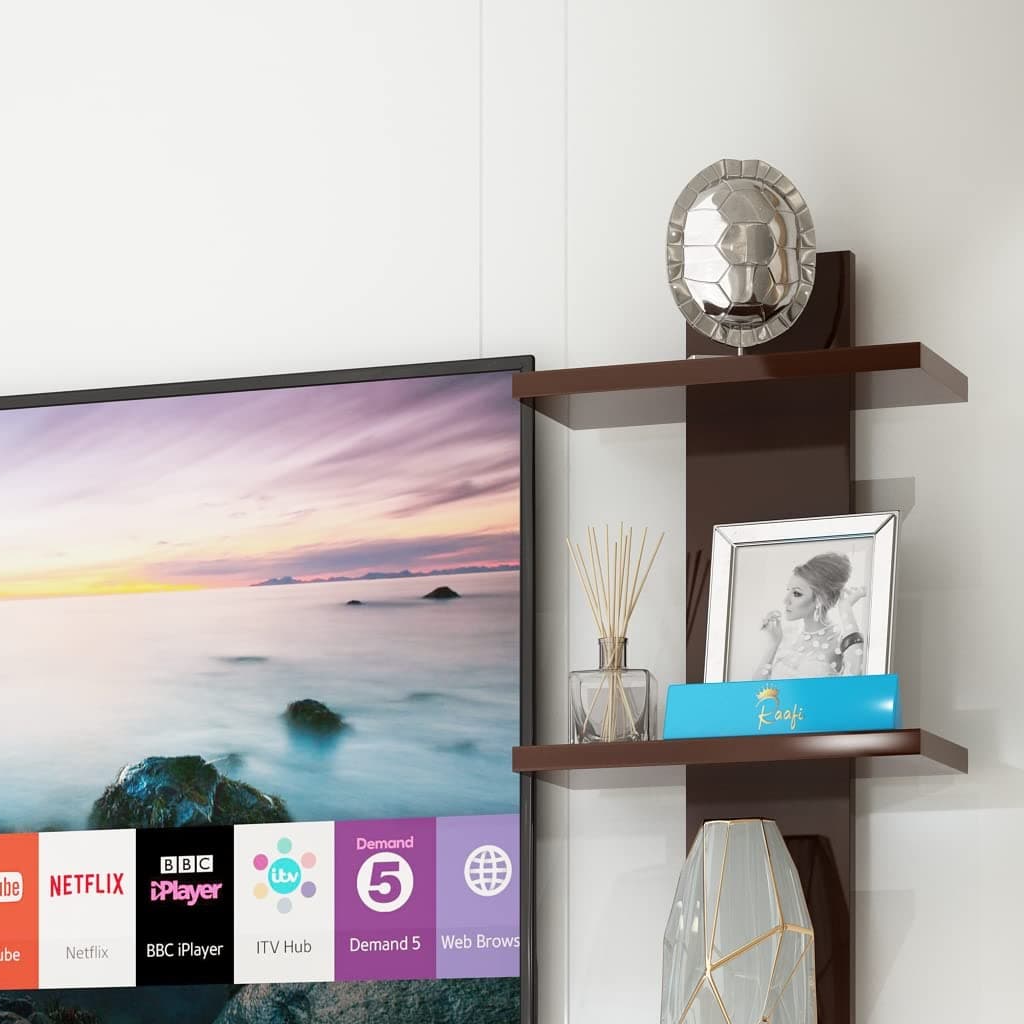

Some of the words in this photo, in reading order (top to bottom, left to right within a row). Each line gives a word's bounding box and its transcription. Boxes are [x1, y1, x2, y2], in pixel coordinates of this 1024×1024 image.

[755, 696, 804, 731] Raafi
[356, 836, 414, 851] Demand
[161, 855, 213, 874] BBC
[50, 872, 124, 897] NETFLIX
[368, 861, 402, 904] 5
[151, 880, 223, 907] iPlayer
[146, 943, 175, 958] BBC
[178, 941, 225, 960] iPlayer
[256, 940, 280, 955] ITV
[284, 939, 312, 954] Hub
[349, 937, 409, 953] Demand
[412, 935, 422, 951] 5
[440, 935, 472, 950] Web
[476, 933, 520, 949] Brows
[66, 945, 109, 960] Netflix
